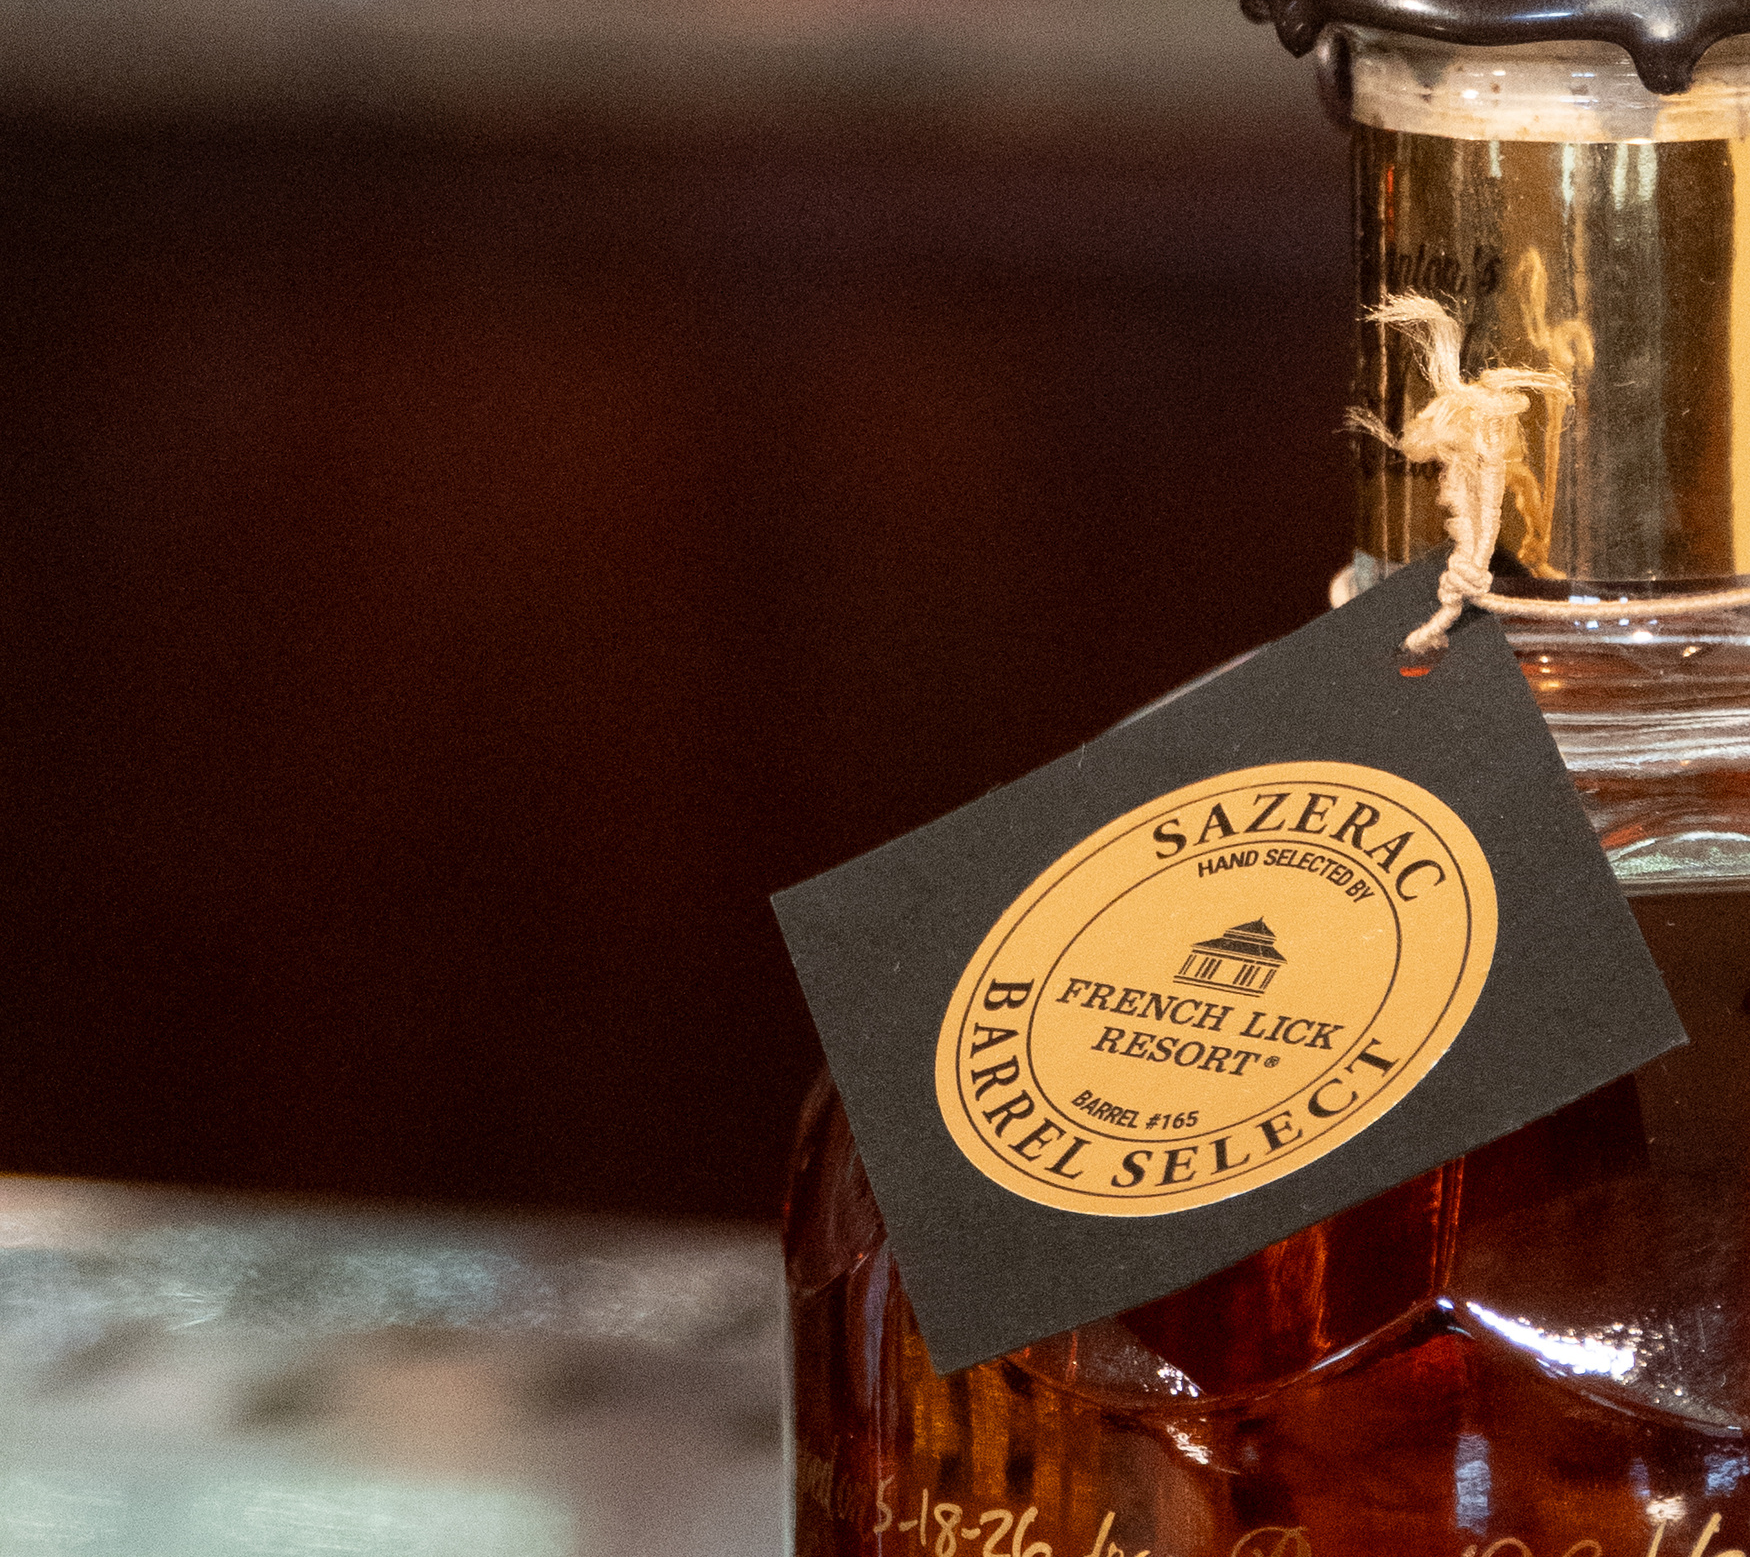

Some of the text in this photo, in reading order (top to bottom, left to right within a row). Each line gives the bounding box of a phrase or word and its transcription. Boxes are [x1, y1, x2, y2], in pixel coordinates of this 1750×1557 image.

[1152, 791, 1447, 903] SAZERAC
[1197, 848, 1375, 903] HAND SELECTED BY
[1055, 976, 1344, 1051] FRENCH LICK
[971, 978, 1400, 1190] BARREL SELECT
[1071, 1089, 1200, 1131] BARREL #165
